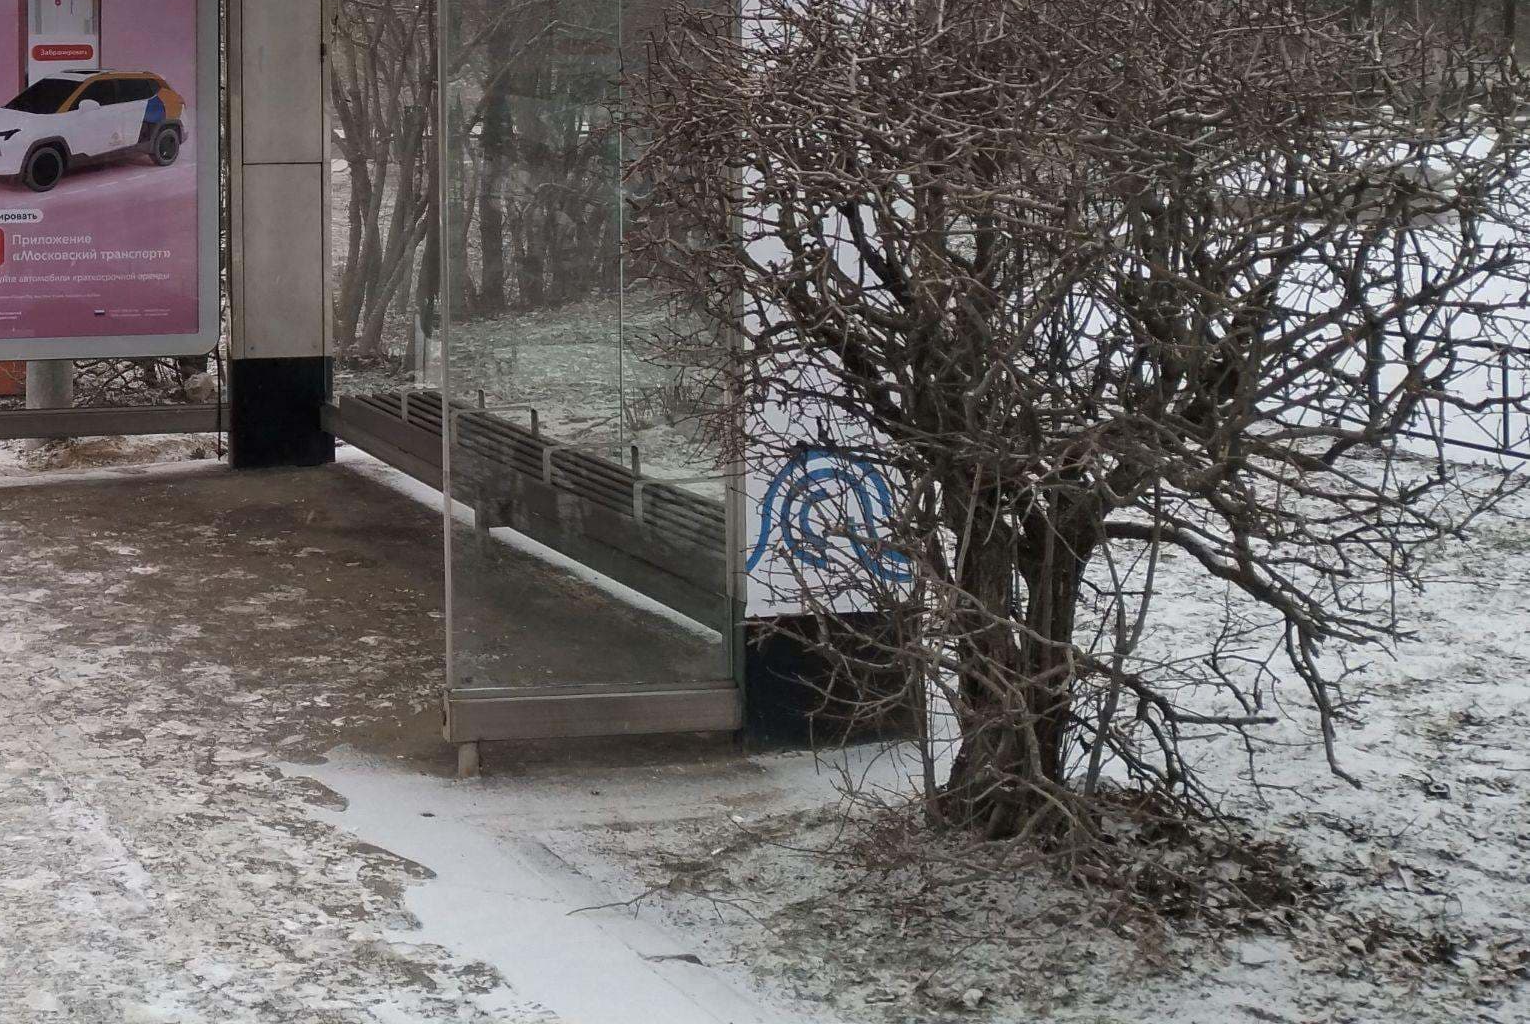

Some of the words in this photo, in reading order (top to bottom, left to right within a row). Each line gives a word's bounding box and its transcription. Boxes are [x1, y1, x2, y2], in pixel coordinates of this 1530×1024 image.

[12, 234, 92, 246] Приложение
[12, 249, 97, 262] «Московский
[101, 249, 171, 262] транспорт»
